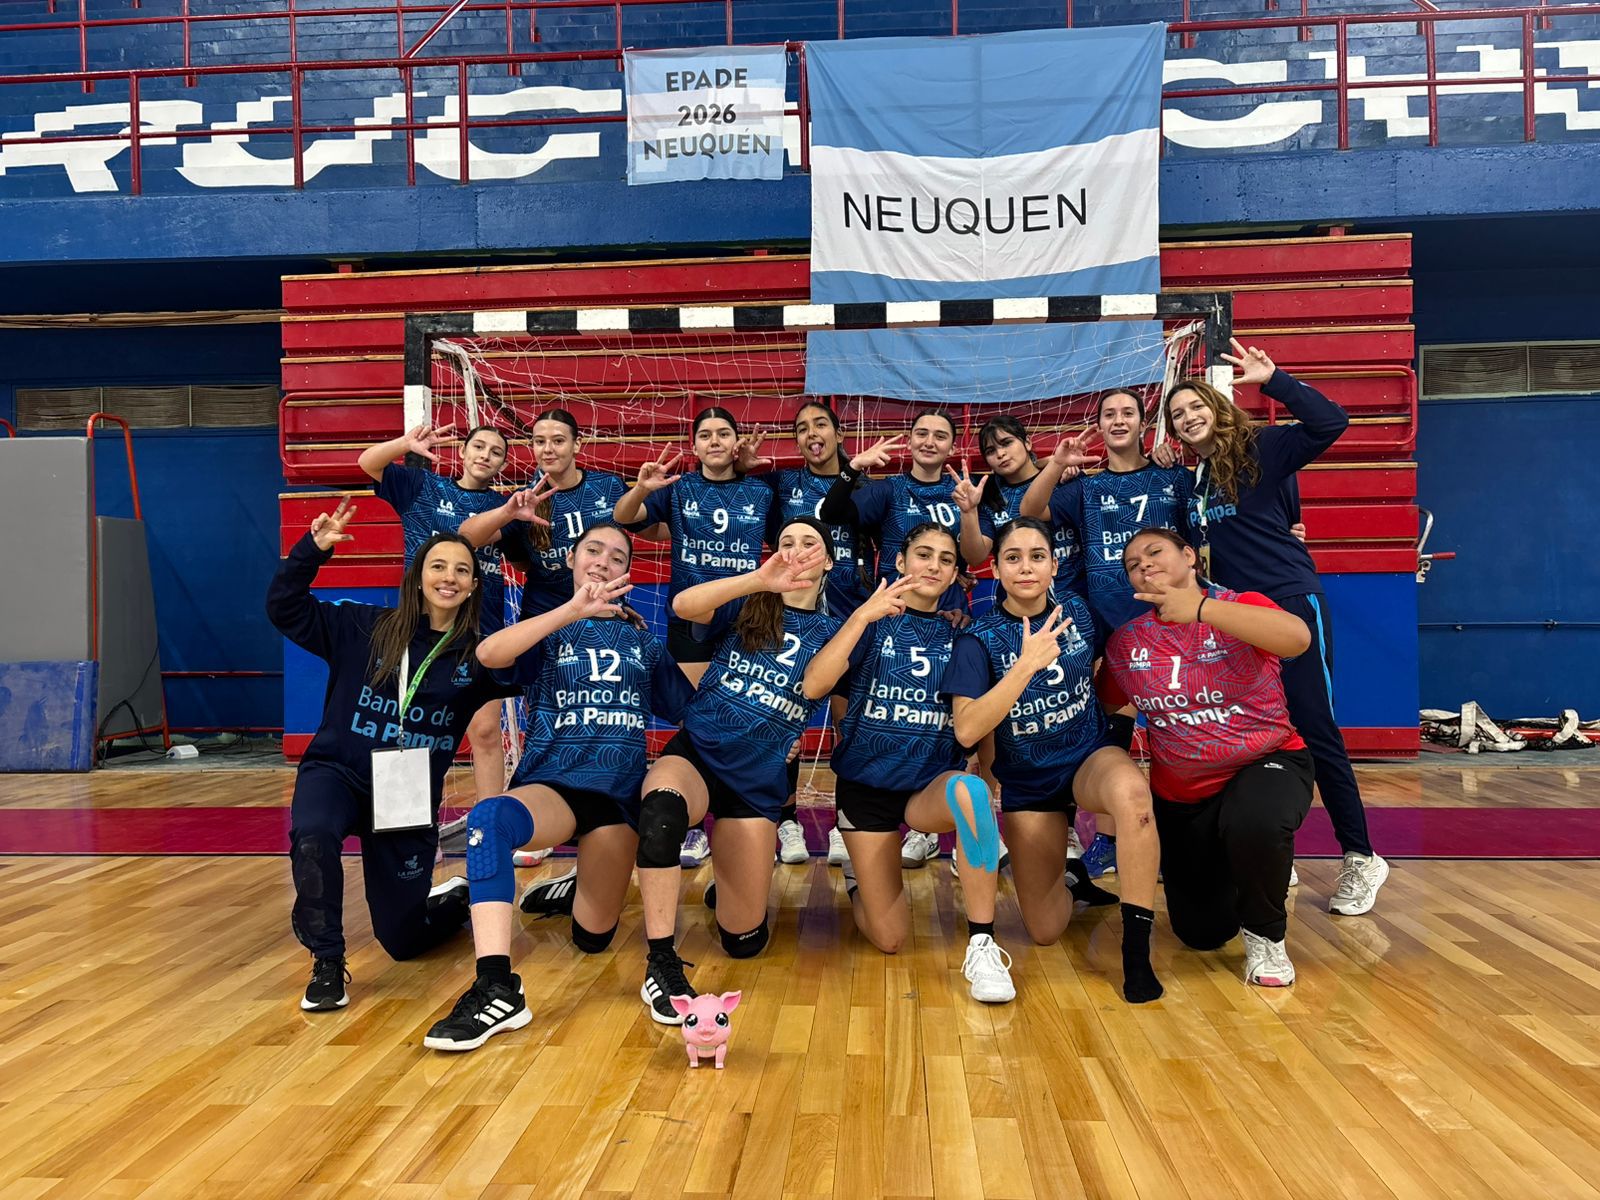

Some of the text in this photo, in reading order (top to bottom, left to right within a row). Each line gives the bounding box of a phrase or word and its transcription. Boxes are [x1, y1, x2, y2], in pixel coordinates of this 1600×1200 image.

[666, 68, 748, 92] EPADE
[678, 103, 737, 127] 2026
[643, 128, 771, 160] NEUQUÉN
[843, 188, 1087, 236] NEUQUEN
[440, 499, 453, 512] LA
[685, 499, 698, 511] LA
[1101, 495, 1115, 505] LA
[1130, 494, 1149, 522] 7
[564, 511, 584, 538] 11
[713, 508, 729, 533] 9
[926, 502, 955, 527] 10
[682, 534, 749, 553] Banco de
[831, 526, 849, 542] de
[1055, 527, 1074, 541] de
[681, 548, 757, 572] La Pampa
[1104, 548, 1122, 561] La
[559, 642, 574, 656] LA
[775, 632, 801, 667] 2
[1001, 652, 1018, 669] LA
[1131, 647, 1148, 661] LA
[585, 648, 622, 681] 12
[728, 650, 789, 687] Banco
[910, 646, 931, 677] 5
[1168, 655, 1182, 689] 1
[720, 671, 744, 693] La
[358, 685, 454, 726] Bano de
[556, 686, 640, 709] Banco de
[1009, 676, 1090, 718] Banco de
[1133, 685, 1224, 711] Banco de
[554, 707, 645, 731] La Pampa
[864, 699, 888, 720] La
[351, 712, 378, 738] La
[1011, 721, 1039, 736] La
